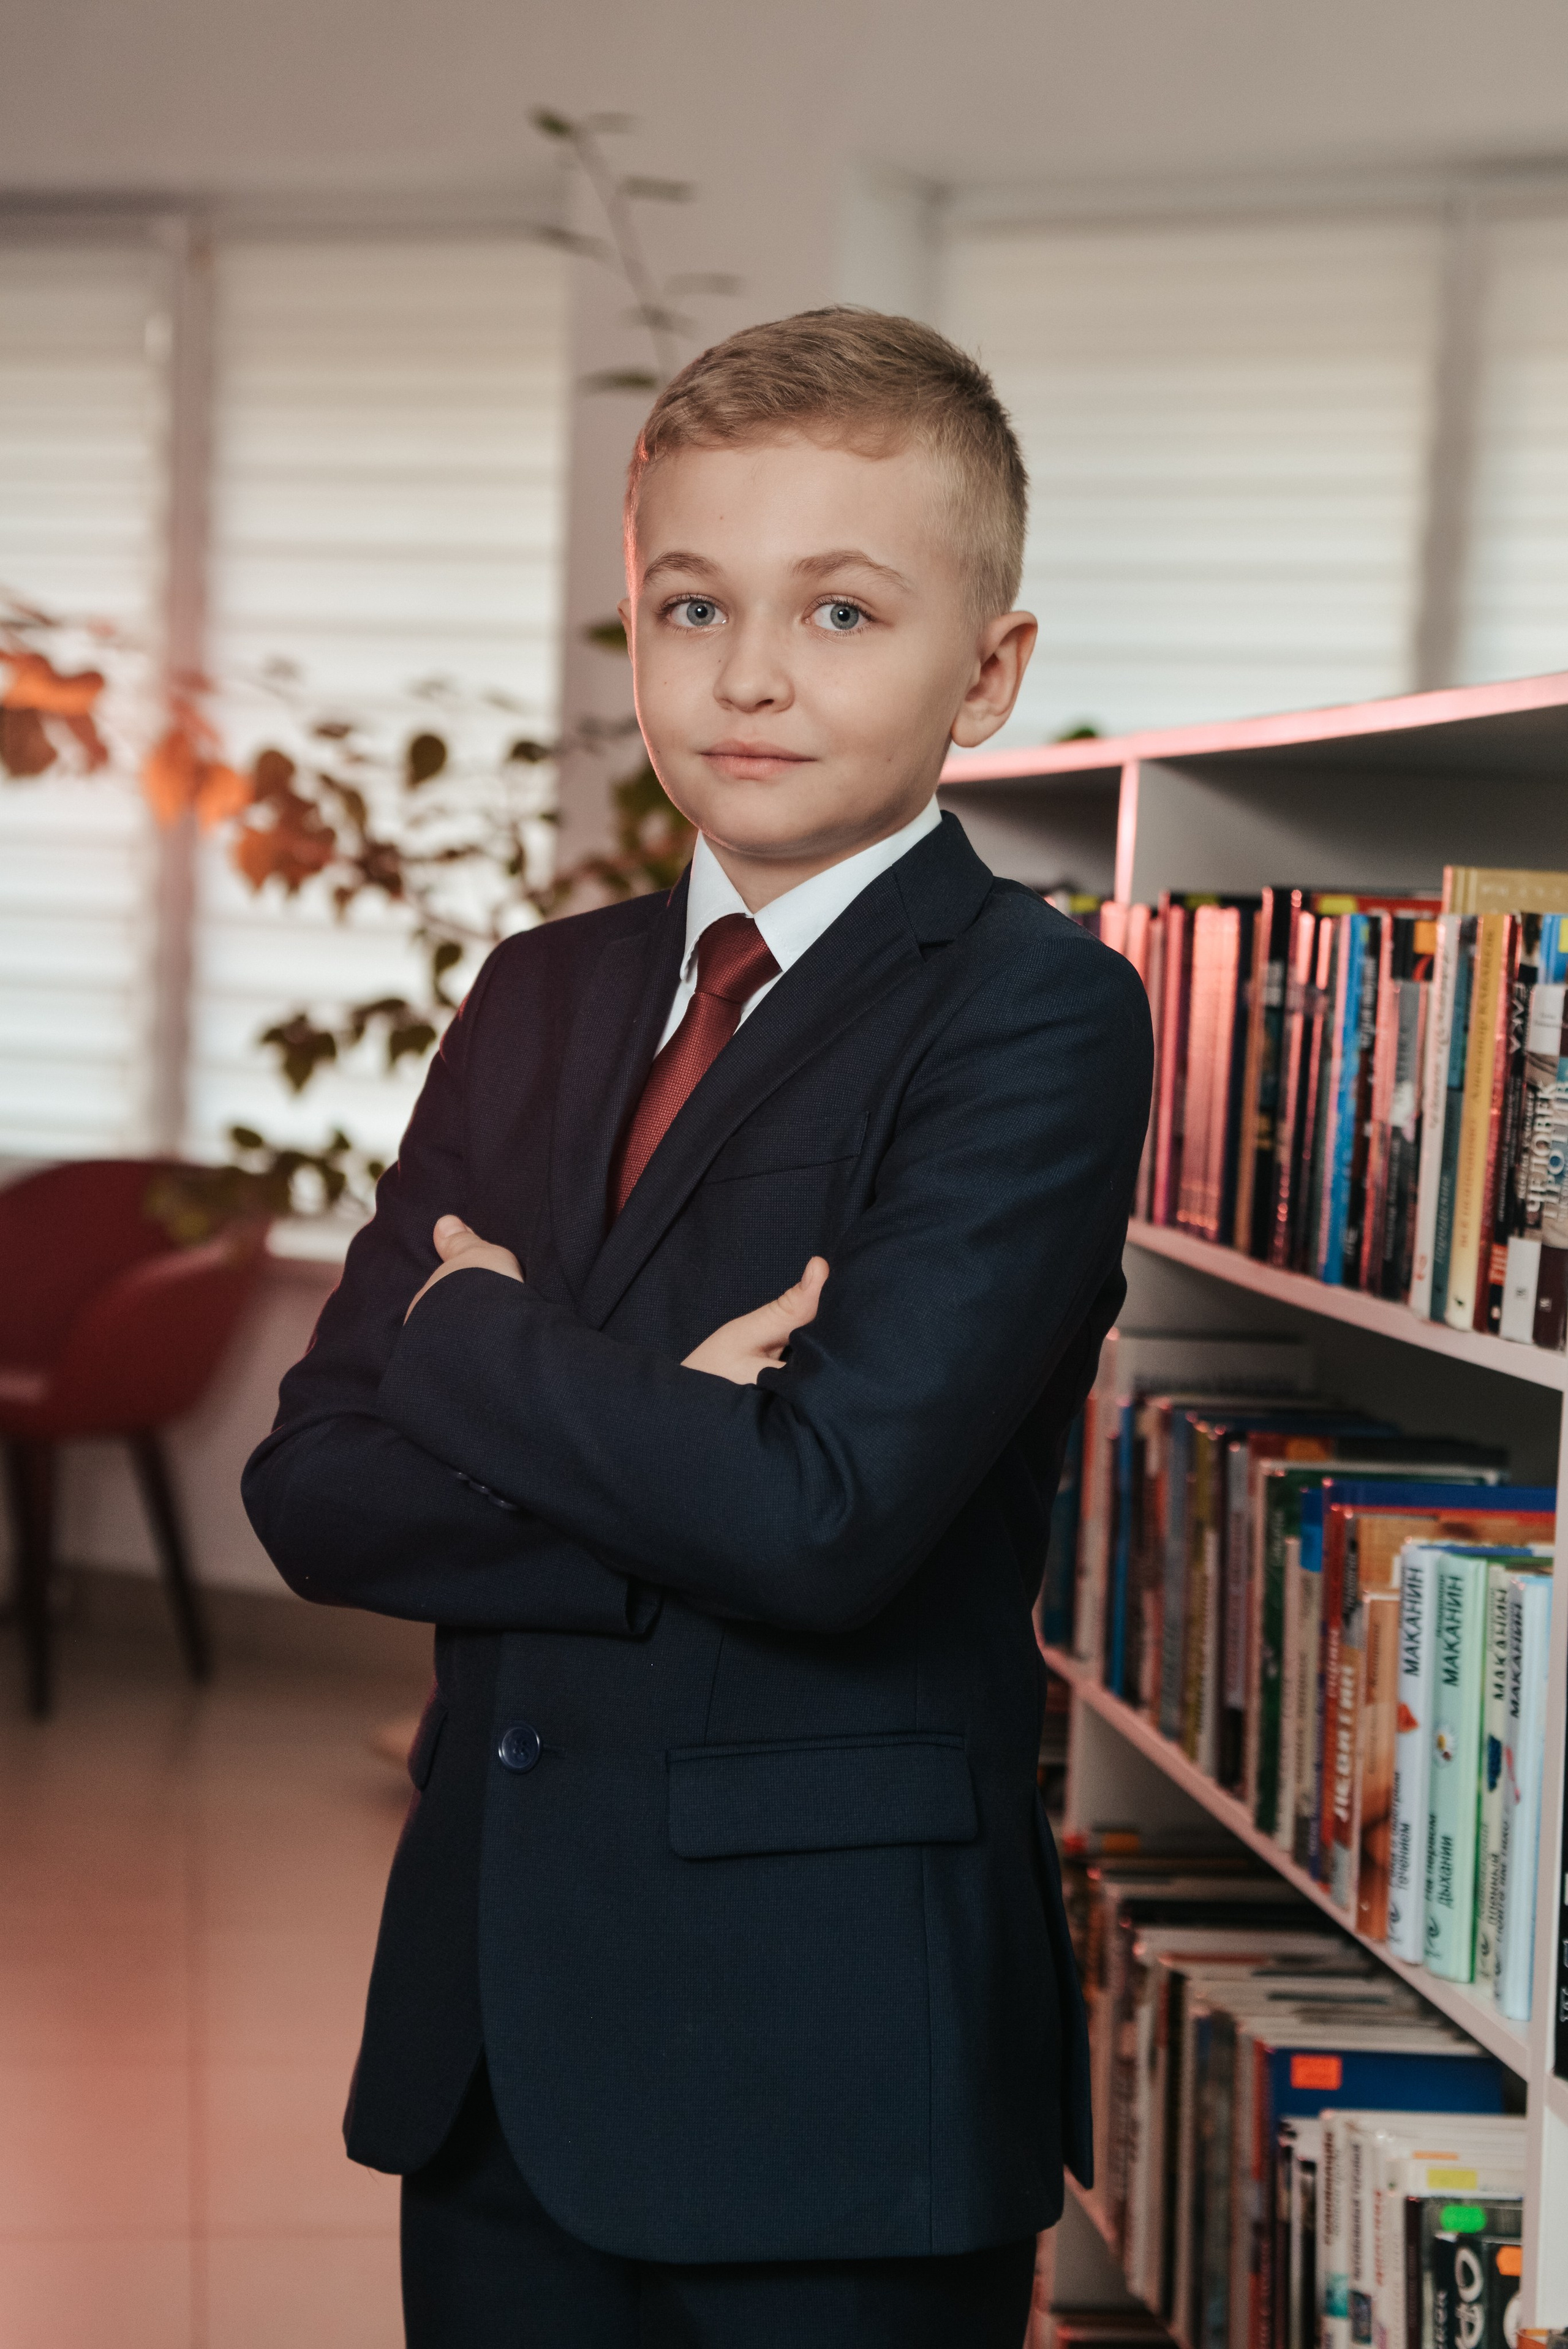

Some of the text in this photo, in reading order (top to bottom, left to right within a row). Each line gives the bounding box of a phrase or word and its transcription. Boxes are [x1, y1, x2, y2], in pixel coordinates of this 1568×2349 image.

[1526, 1079, 1557, 1212] ЧЕЛОВЕК
[1403, 1568, 1423, 1676] МАКАНИН
[1442, 1576, 1463, 1687] МАКАНИН
[1493, 1589, 1507, 1701] МАКАНИН
[1509, 1603, 1522, 1718] МАКАНИН
